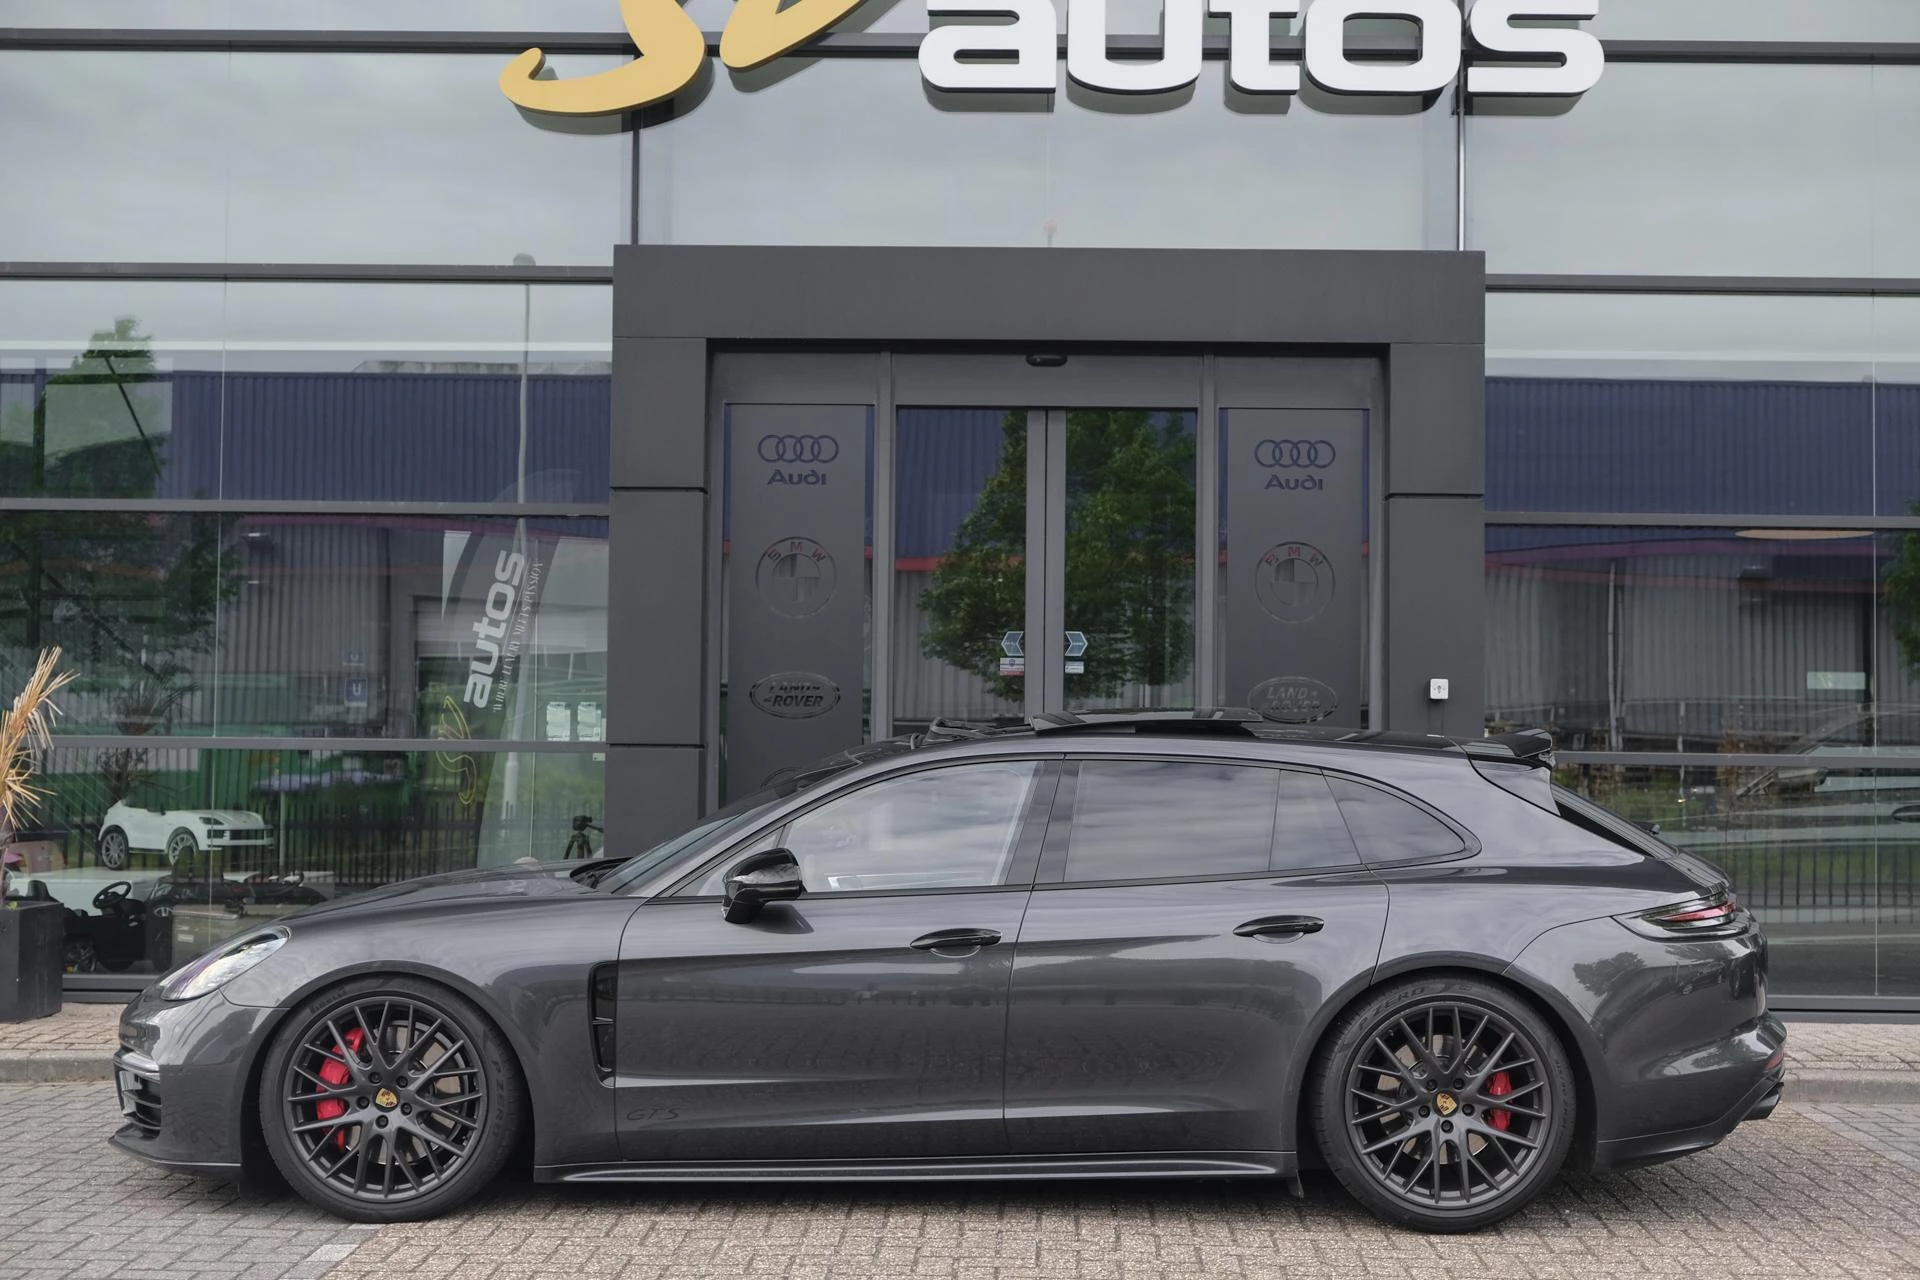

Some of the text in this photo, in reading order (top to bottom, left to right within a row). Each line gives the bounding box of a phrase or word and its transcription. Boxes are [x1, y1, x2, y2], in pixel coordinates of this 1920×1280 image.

[918, 0, 1605, 95] autos
[767, 469, 827, 485] Audi
[1264, 474, 1323, 490] Audi
[463, 549, 525, 709] autos
[772, 695, 824, 707] ROVER
[1267, 687, 1308, 699] LAND
[626, 1108, 680, 1121] GTS
